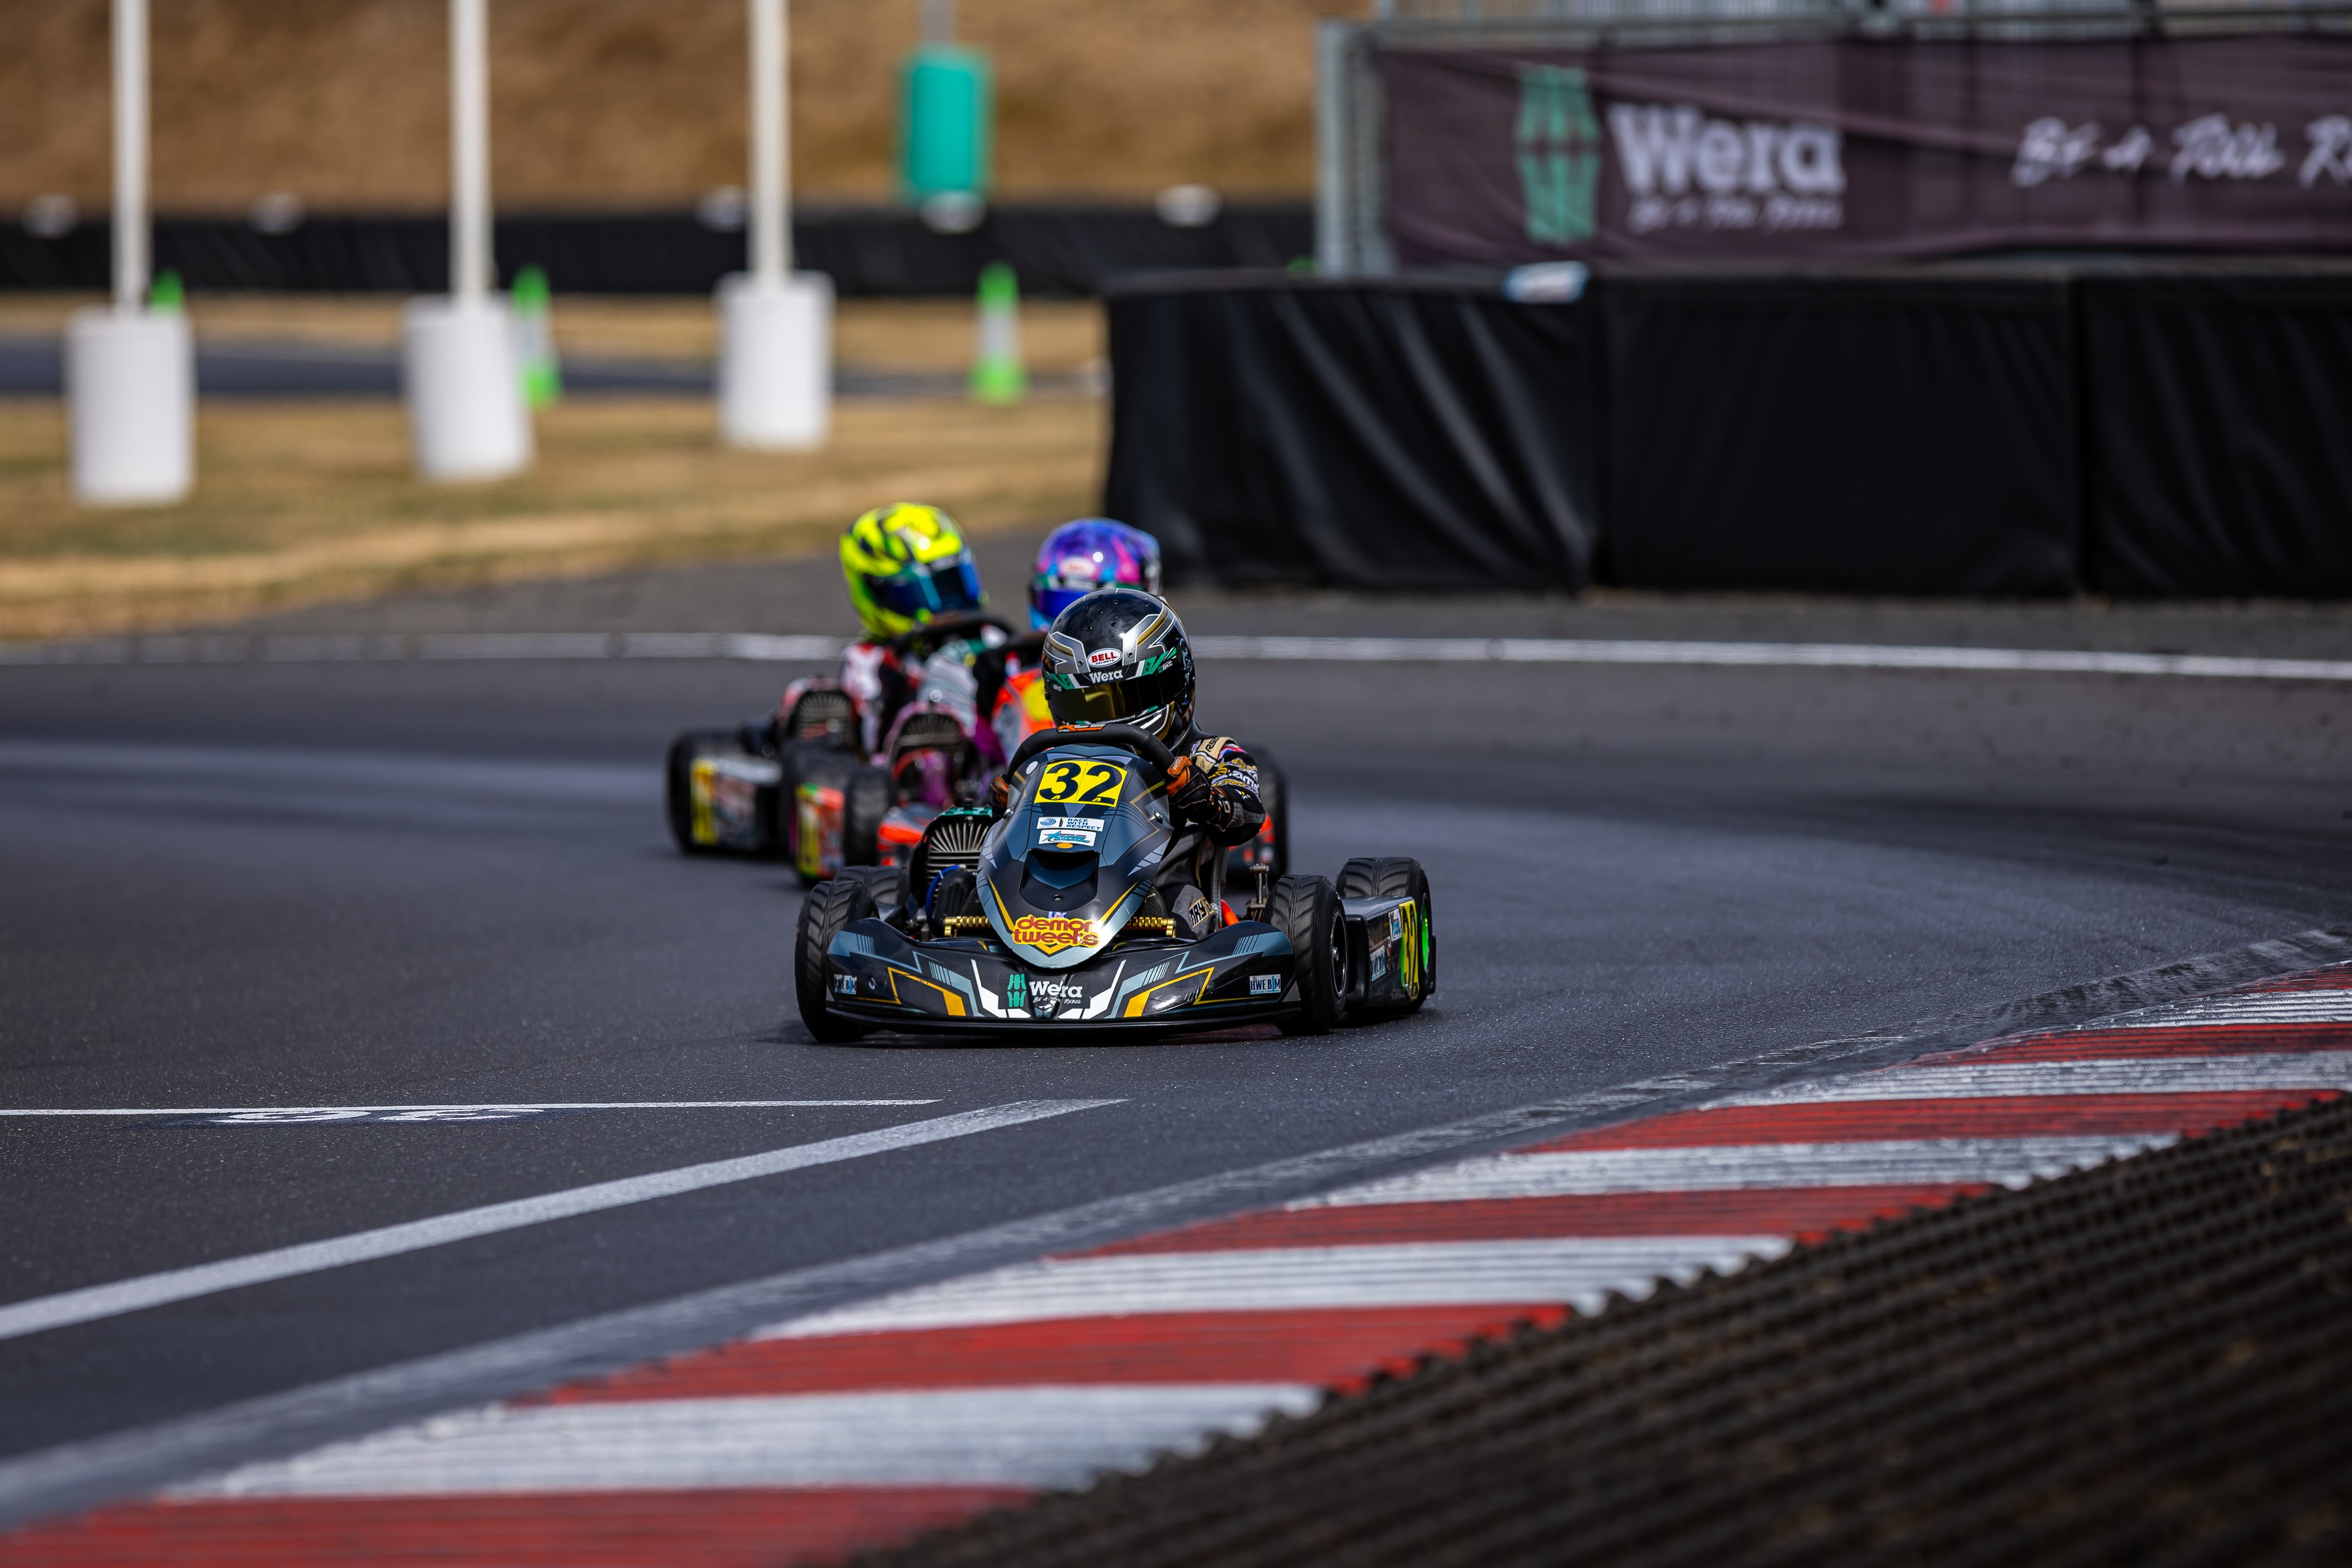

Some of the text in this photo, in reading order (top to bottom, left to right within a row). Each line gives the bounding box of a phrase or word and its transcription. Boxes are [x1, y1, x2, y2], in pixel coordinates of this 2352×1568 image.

[1606, 103, 1847, 194] Wera
[1091, 652, 1117, 663] BELL
[1089, 669, 1123, 684] Wera
[1039, 763, 1122, 805] 32
[1017, 916, 1096, 933] demon
[1013, 929, 1098, 946] tweeks
[1029, 981, 1083, 998] Wera
